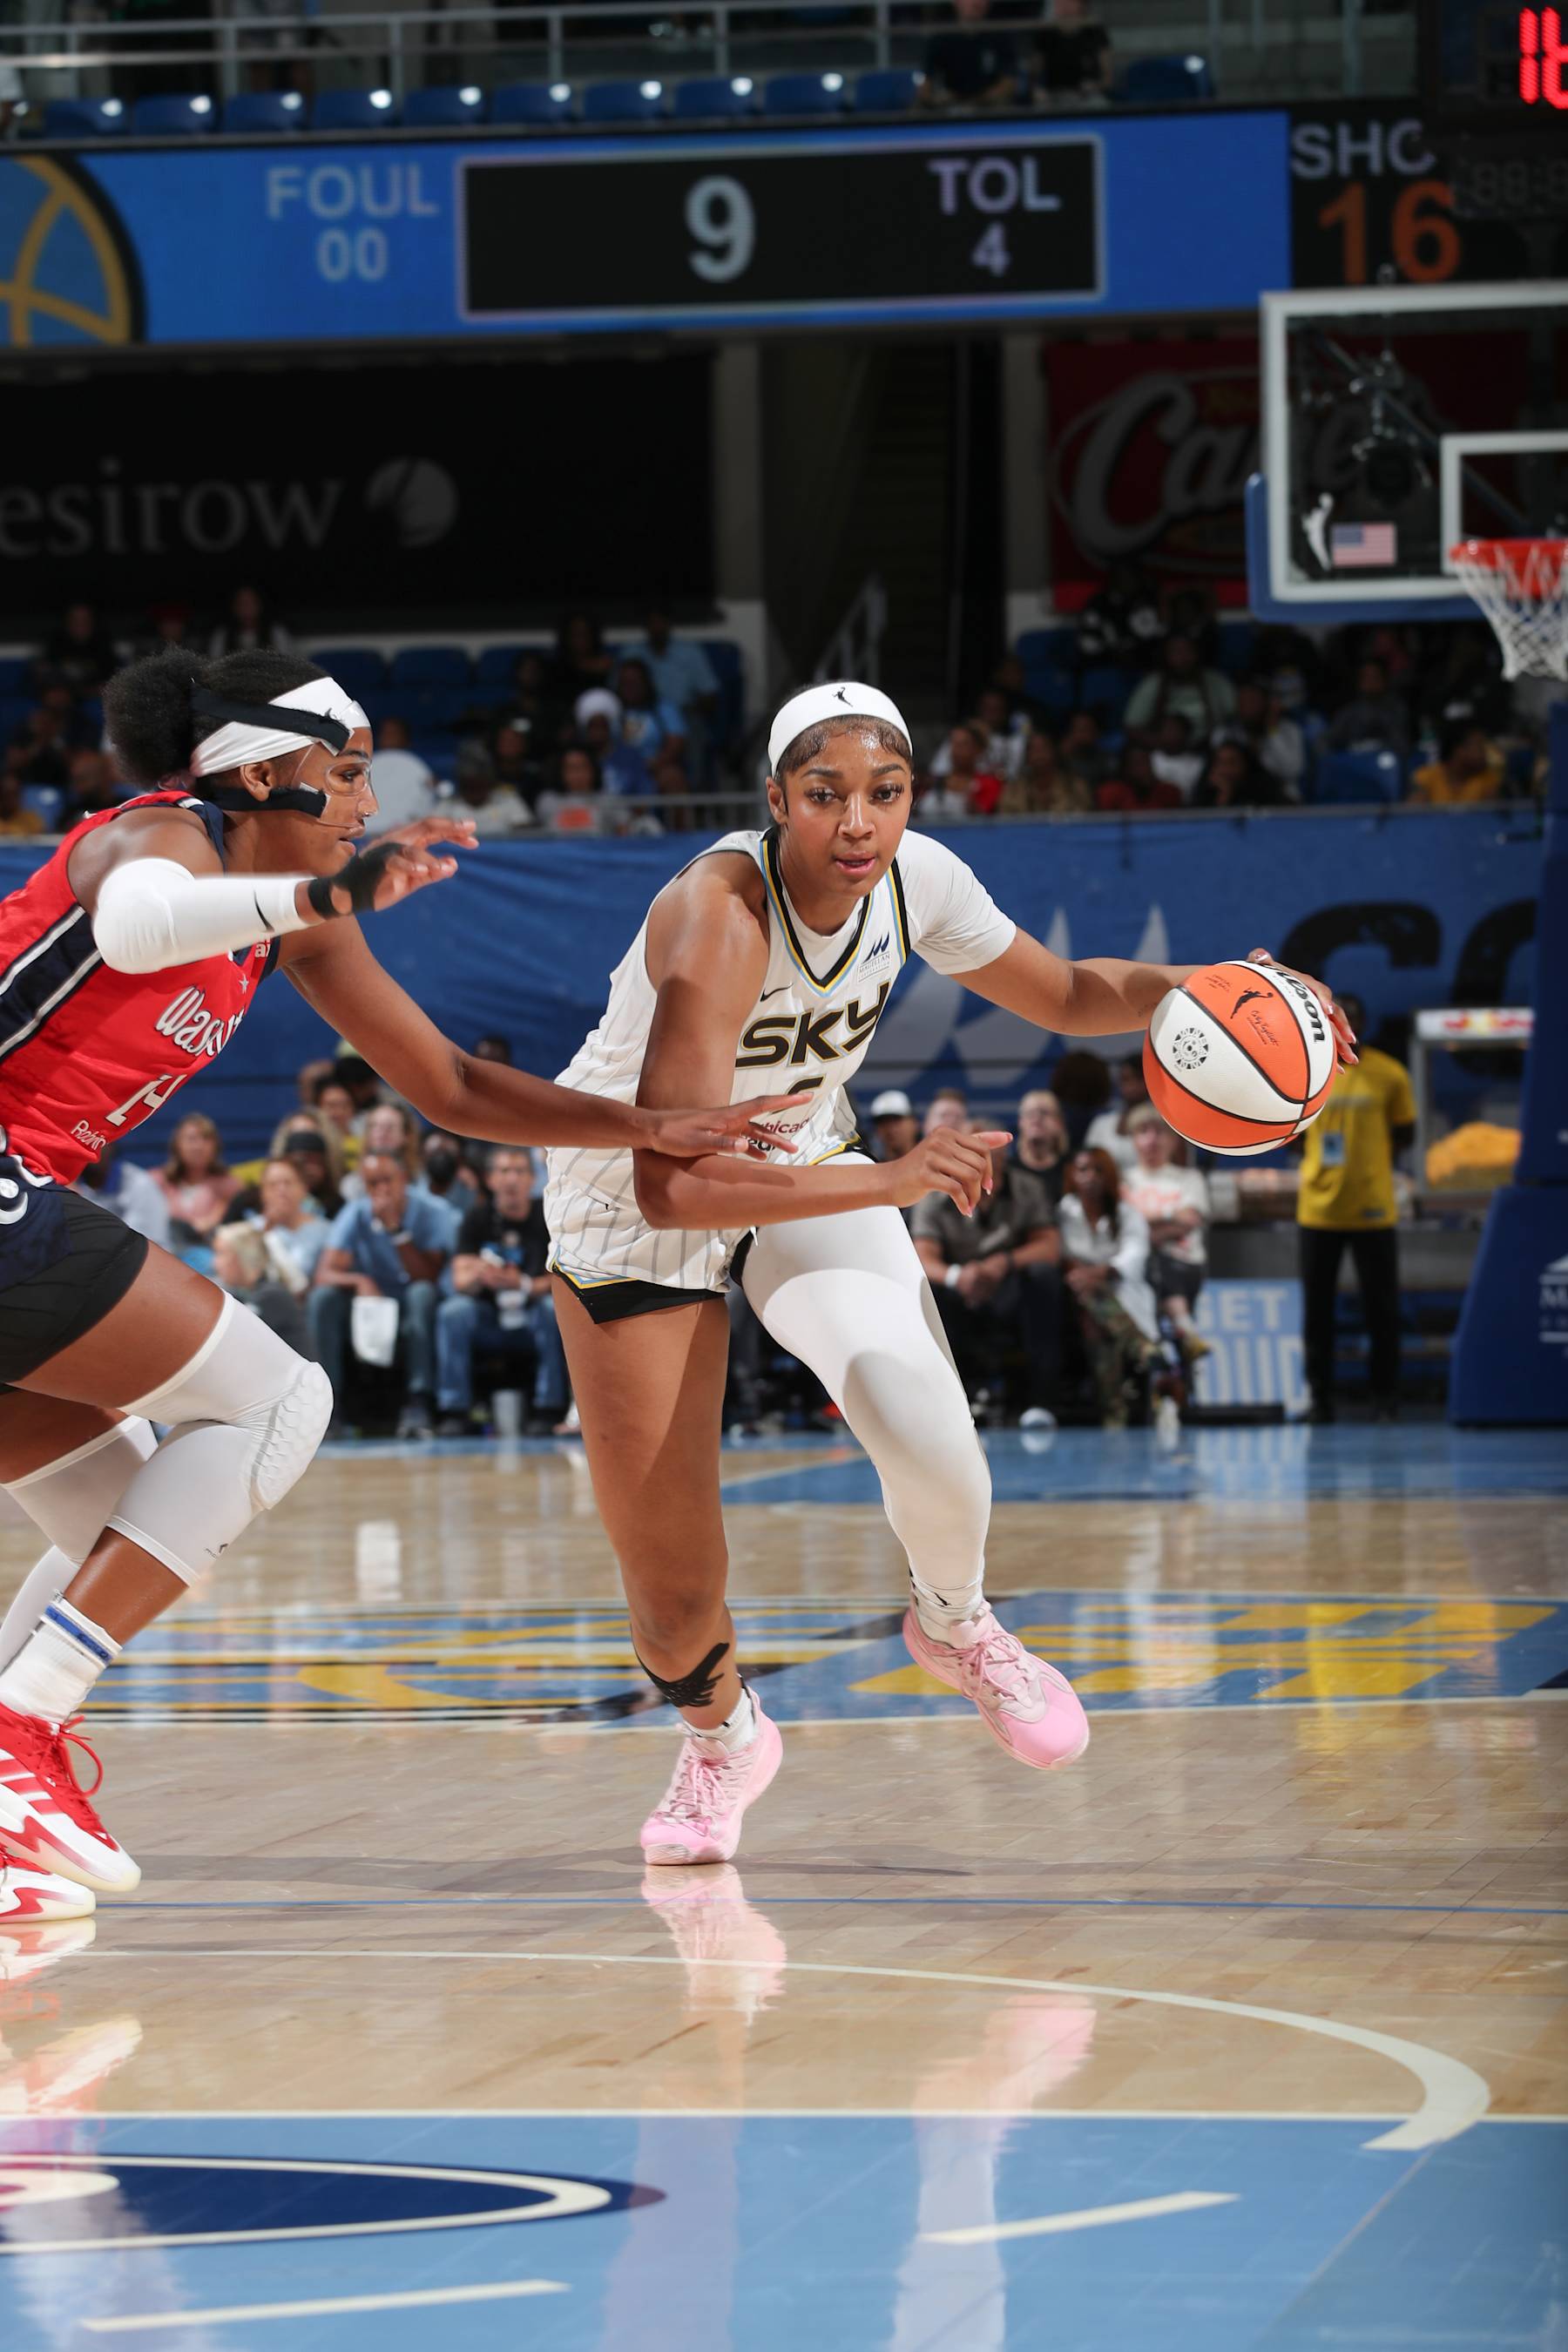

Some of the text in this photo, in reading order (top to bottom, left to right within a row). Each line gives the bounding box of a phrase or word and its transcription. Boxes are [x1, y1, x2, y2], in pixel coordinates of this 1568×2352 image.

[267, 163, 441, 220] FOUL
[929, 155, 1061, 215] TOL
[316, 228, 389, 281] 00
[686, 176, 755, 283] 9
[972, 222, 1010, 276] 4
[1317, 179, 1463, 286] 16
